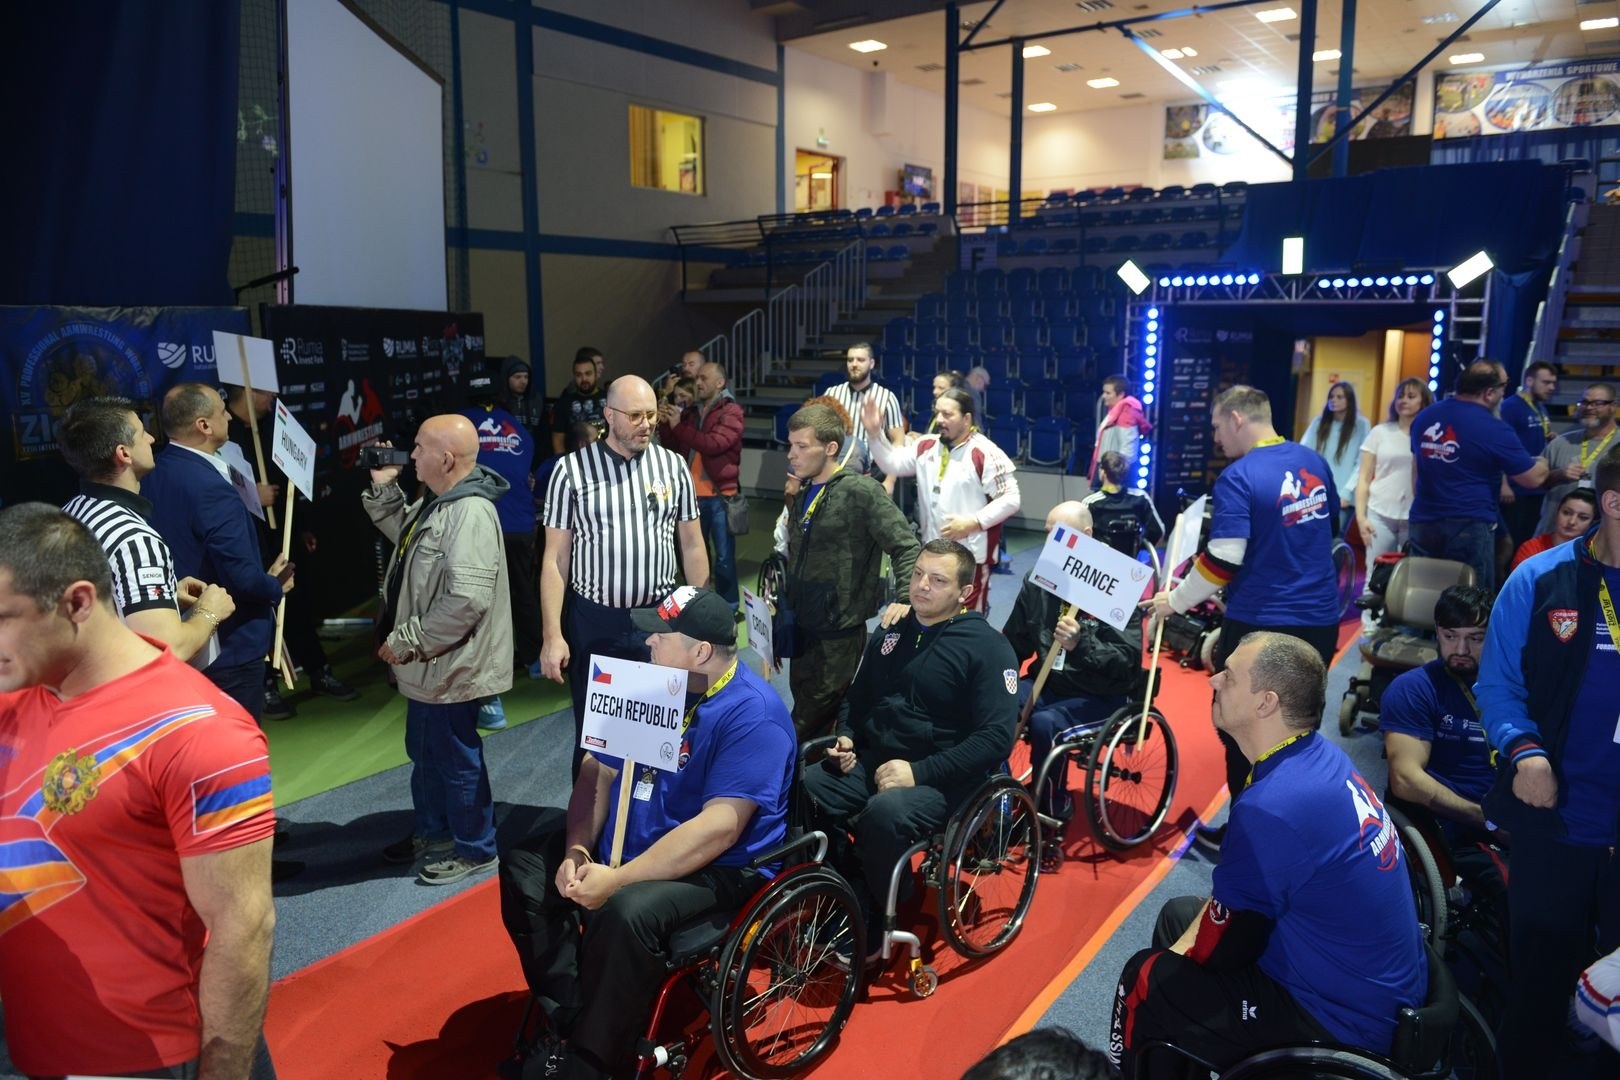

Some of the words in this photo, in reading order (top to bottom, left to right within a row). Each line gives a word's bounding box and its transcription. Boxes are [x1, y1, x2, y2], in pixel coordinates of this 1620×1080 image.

[20, 330, 62, 388] PROFESSIONAL
[60, 323, 126, 350] ARMWRESTLING
[281, 430, 308, 471] HUNGARY
[1281, 492, 1328, 516] ARMWRESTLING
[1062, 555, 1119, 596] FRANCE
[590, 692, 624, 719] CZECH
[625, 699, 679, 731] REPUBLIC
